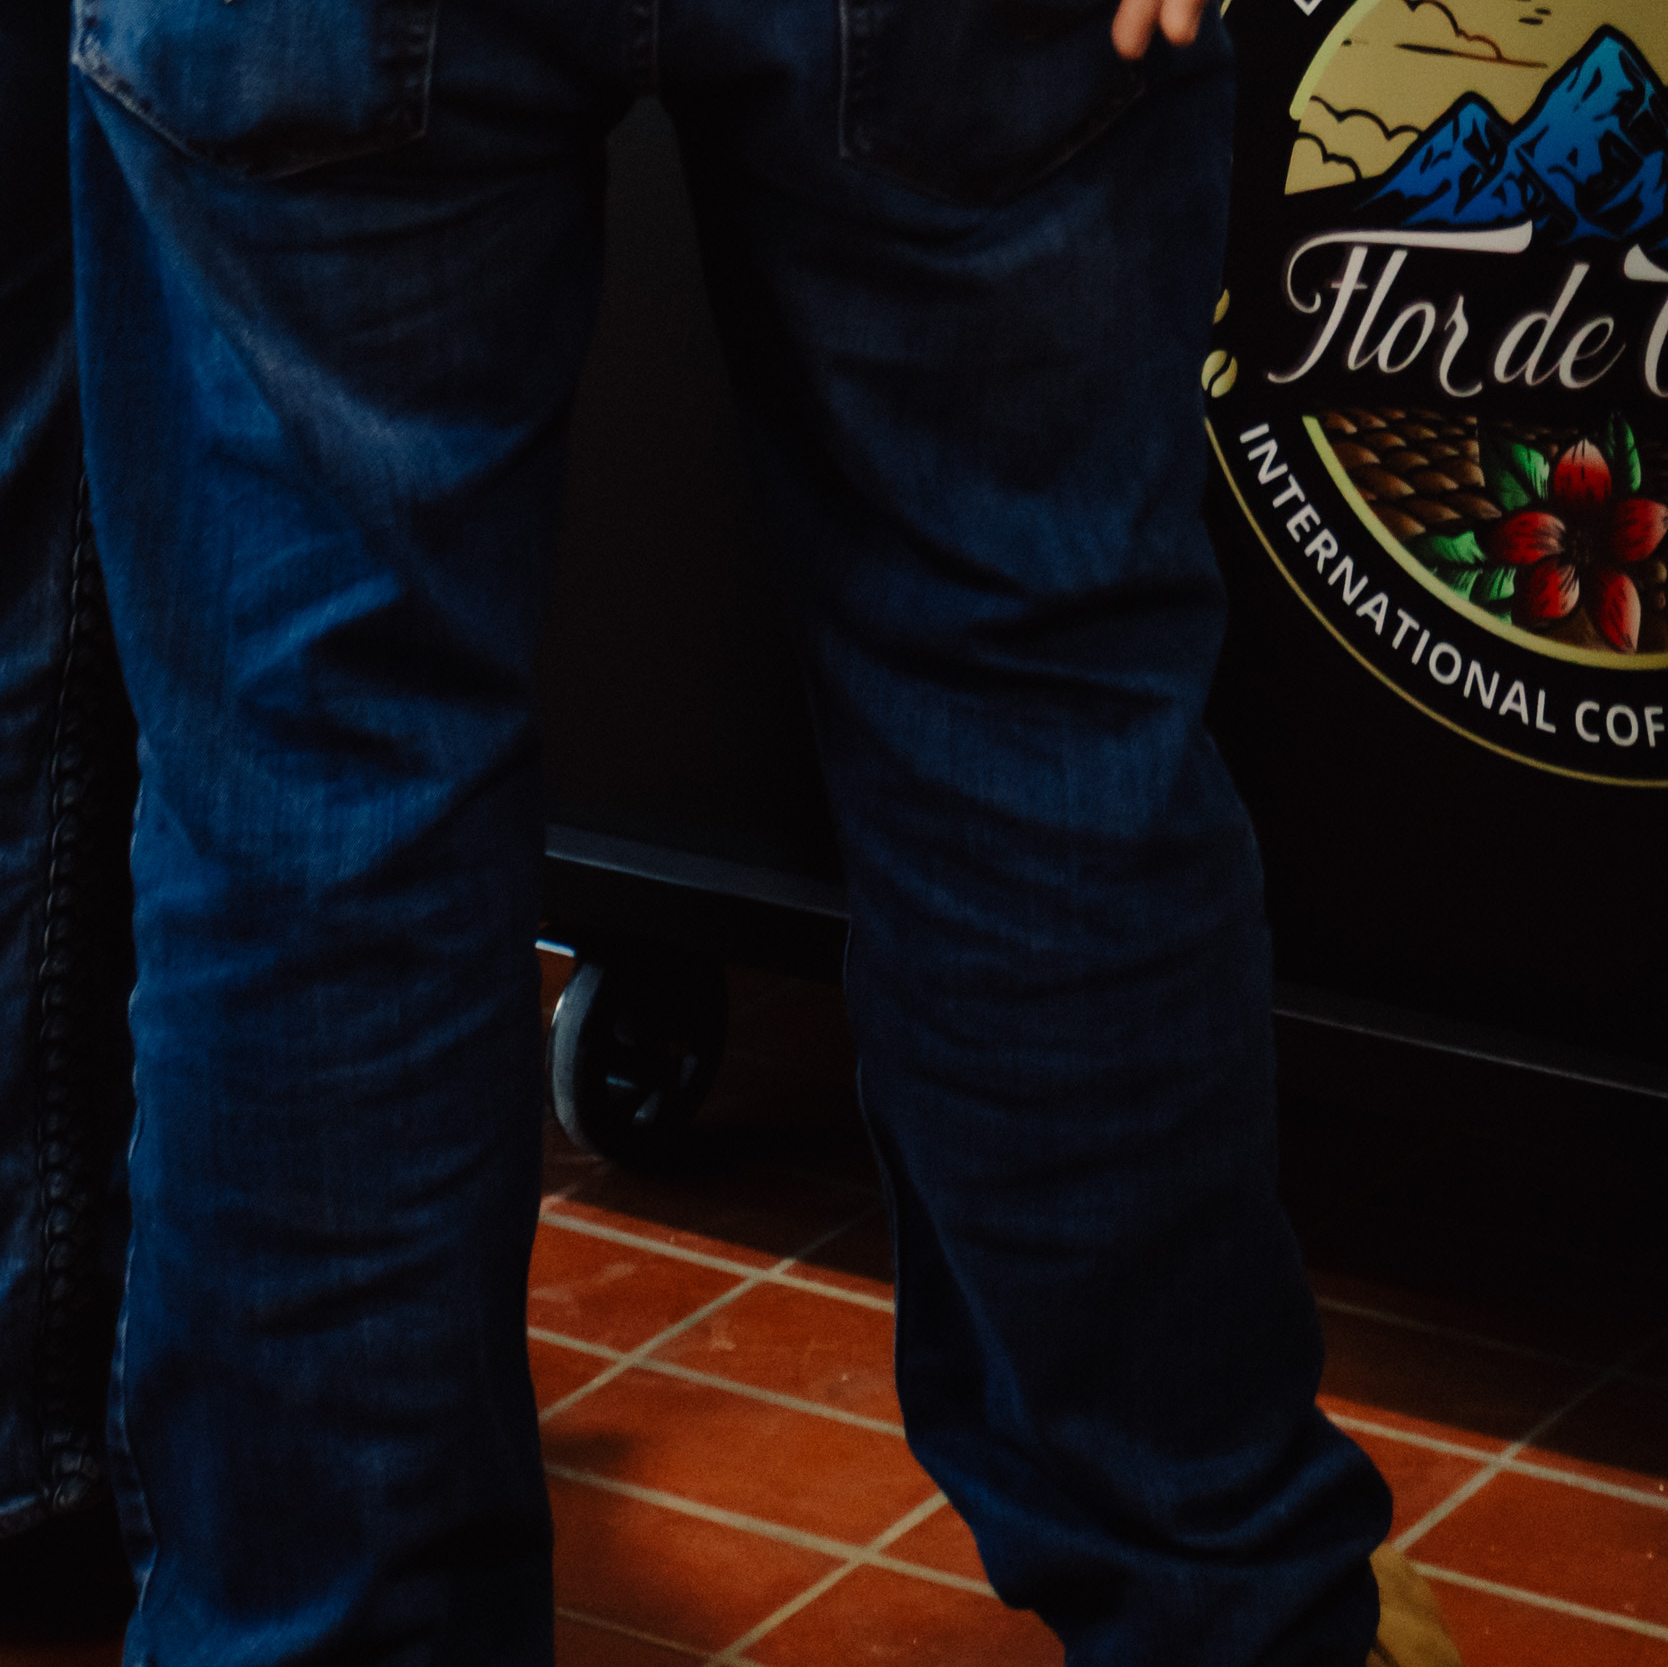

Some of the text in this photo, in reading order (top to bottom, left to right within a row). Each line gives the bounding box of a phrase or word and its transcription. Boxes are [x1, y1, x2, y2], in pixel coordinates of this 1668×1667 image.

[1267, 219, 1534, 398] Flor
[1493, 262, 1627, 389] de
[1238, 422, 1557, 735] INTERNATIONAL
